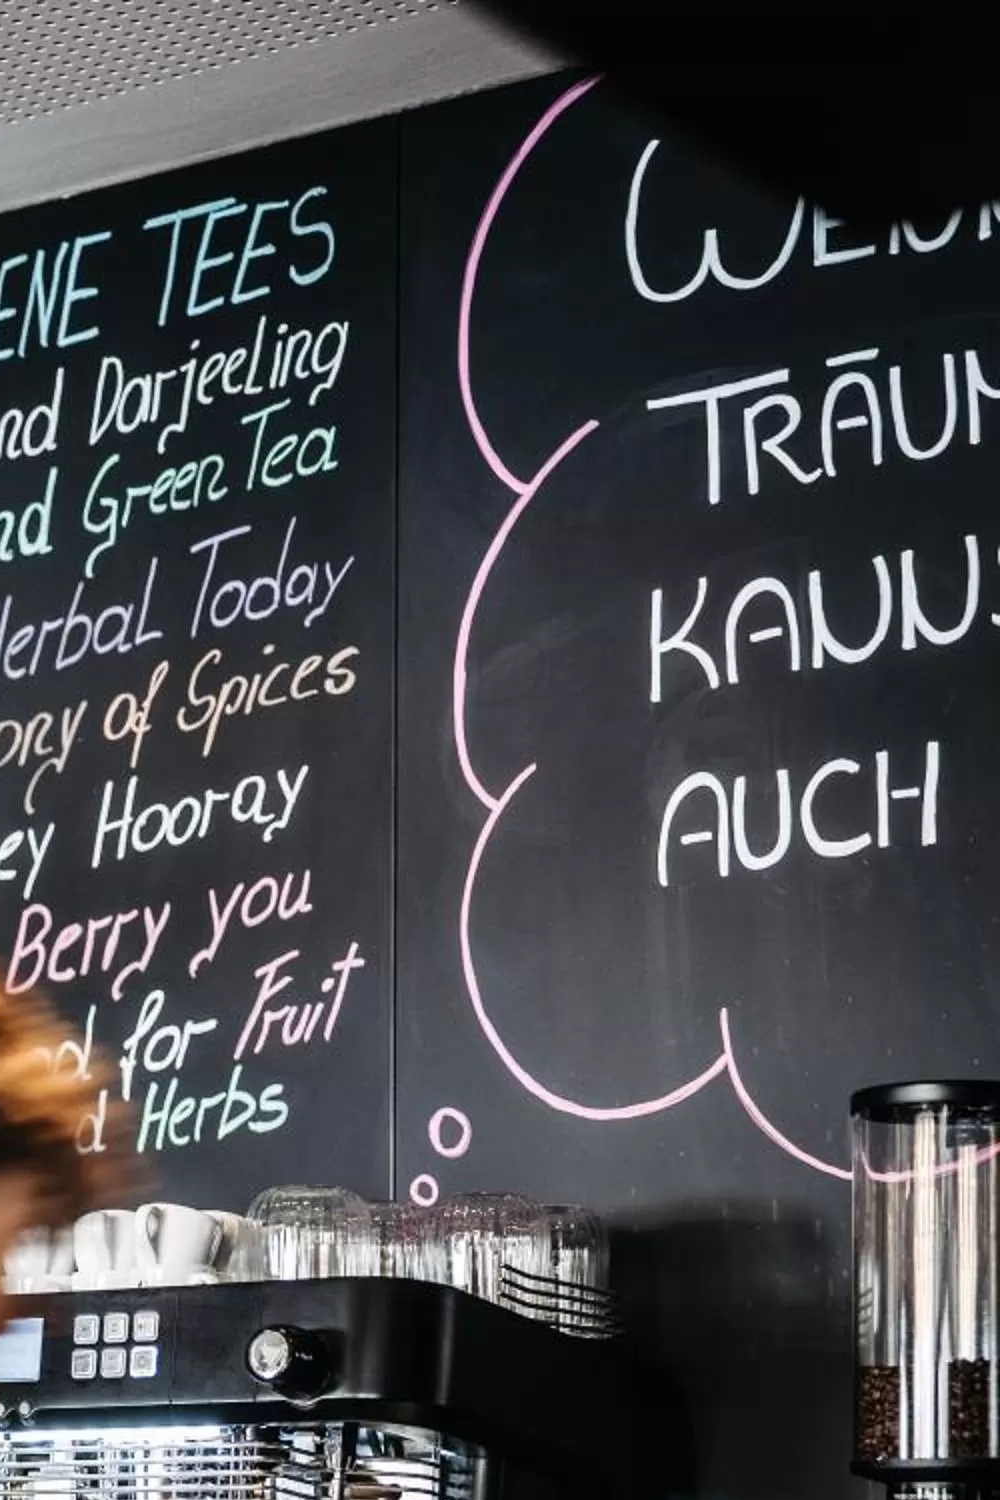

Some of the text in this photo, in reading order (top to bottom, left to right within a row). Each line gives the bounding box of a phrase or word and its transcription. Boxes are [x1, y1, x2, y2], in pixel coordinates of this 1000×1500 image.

[142, 185, 335, 326] TEES
[82, 454, 229, 578] Green
[240, 398, 339, 491] Tea
[189, 515, 355, 638] Today
[649, 533, 1000, 702] KANN
[103, 661, 169, 768] of
[177, 642, 360, 758] Spices
[92, 765, 309, 869] Hooray
[657, 740, 941, 888] AUCH
[5, 901, 171, 1002] Berry
[188, 868, 313, 980] you
[118, 988, 218, 1101] for
[233, 941, 365, 1061] Fruit
[136, 1064, 289, 1154] Herbs
